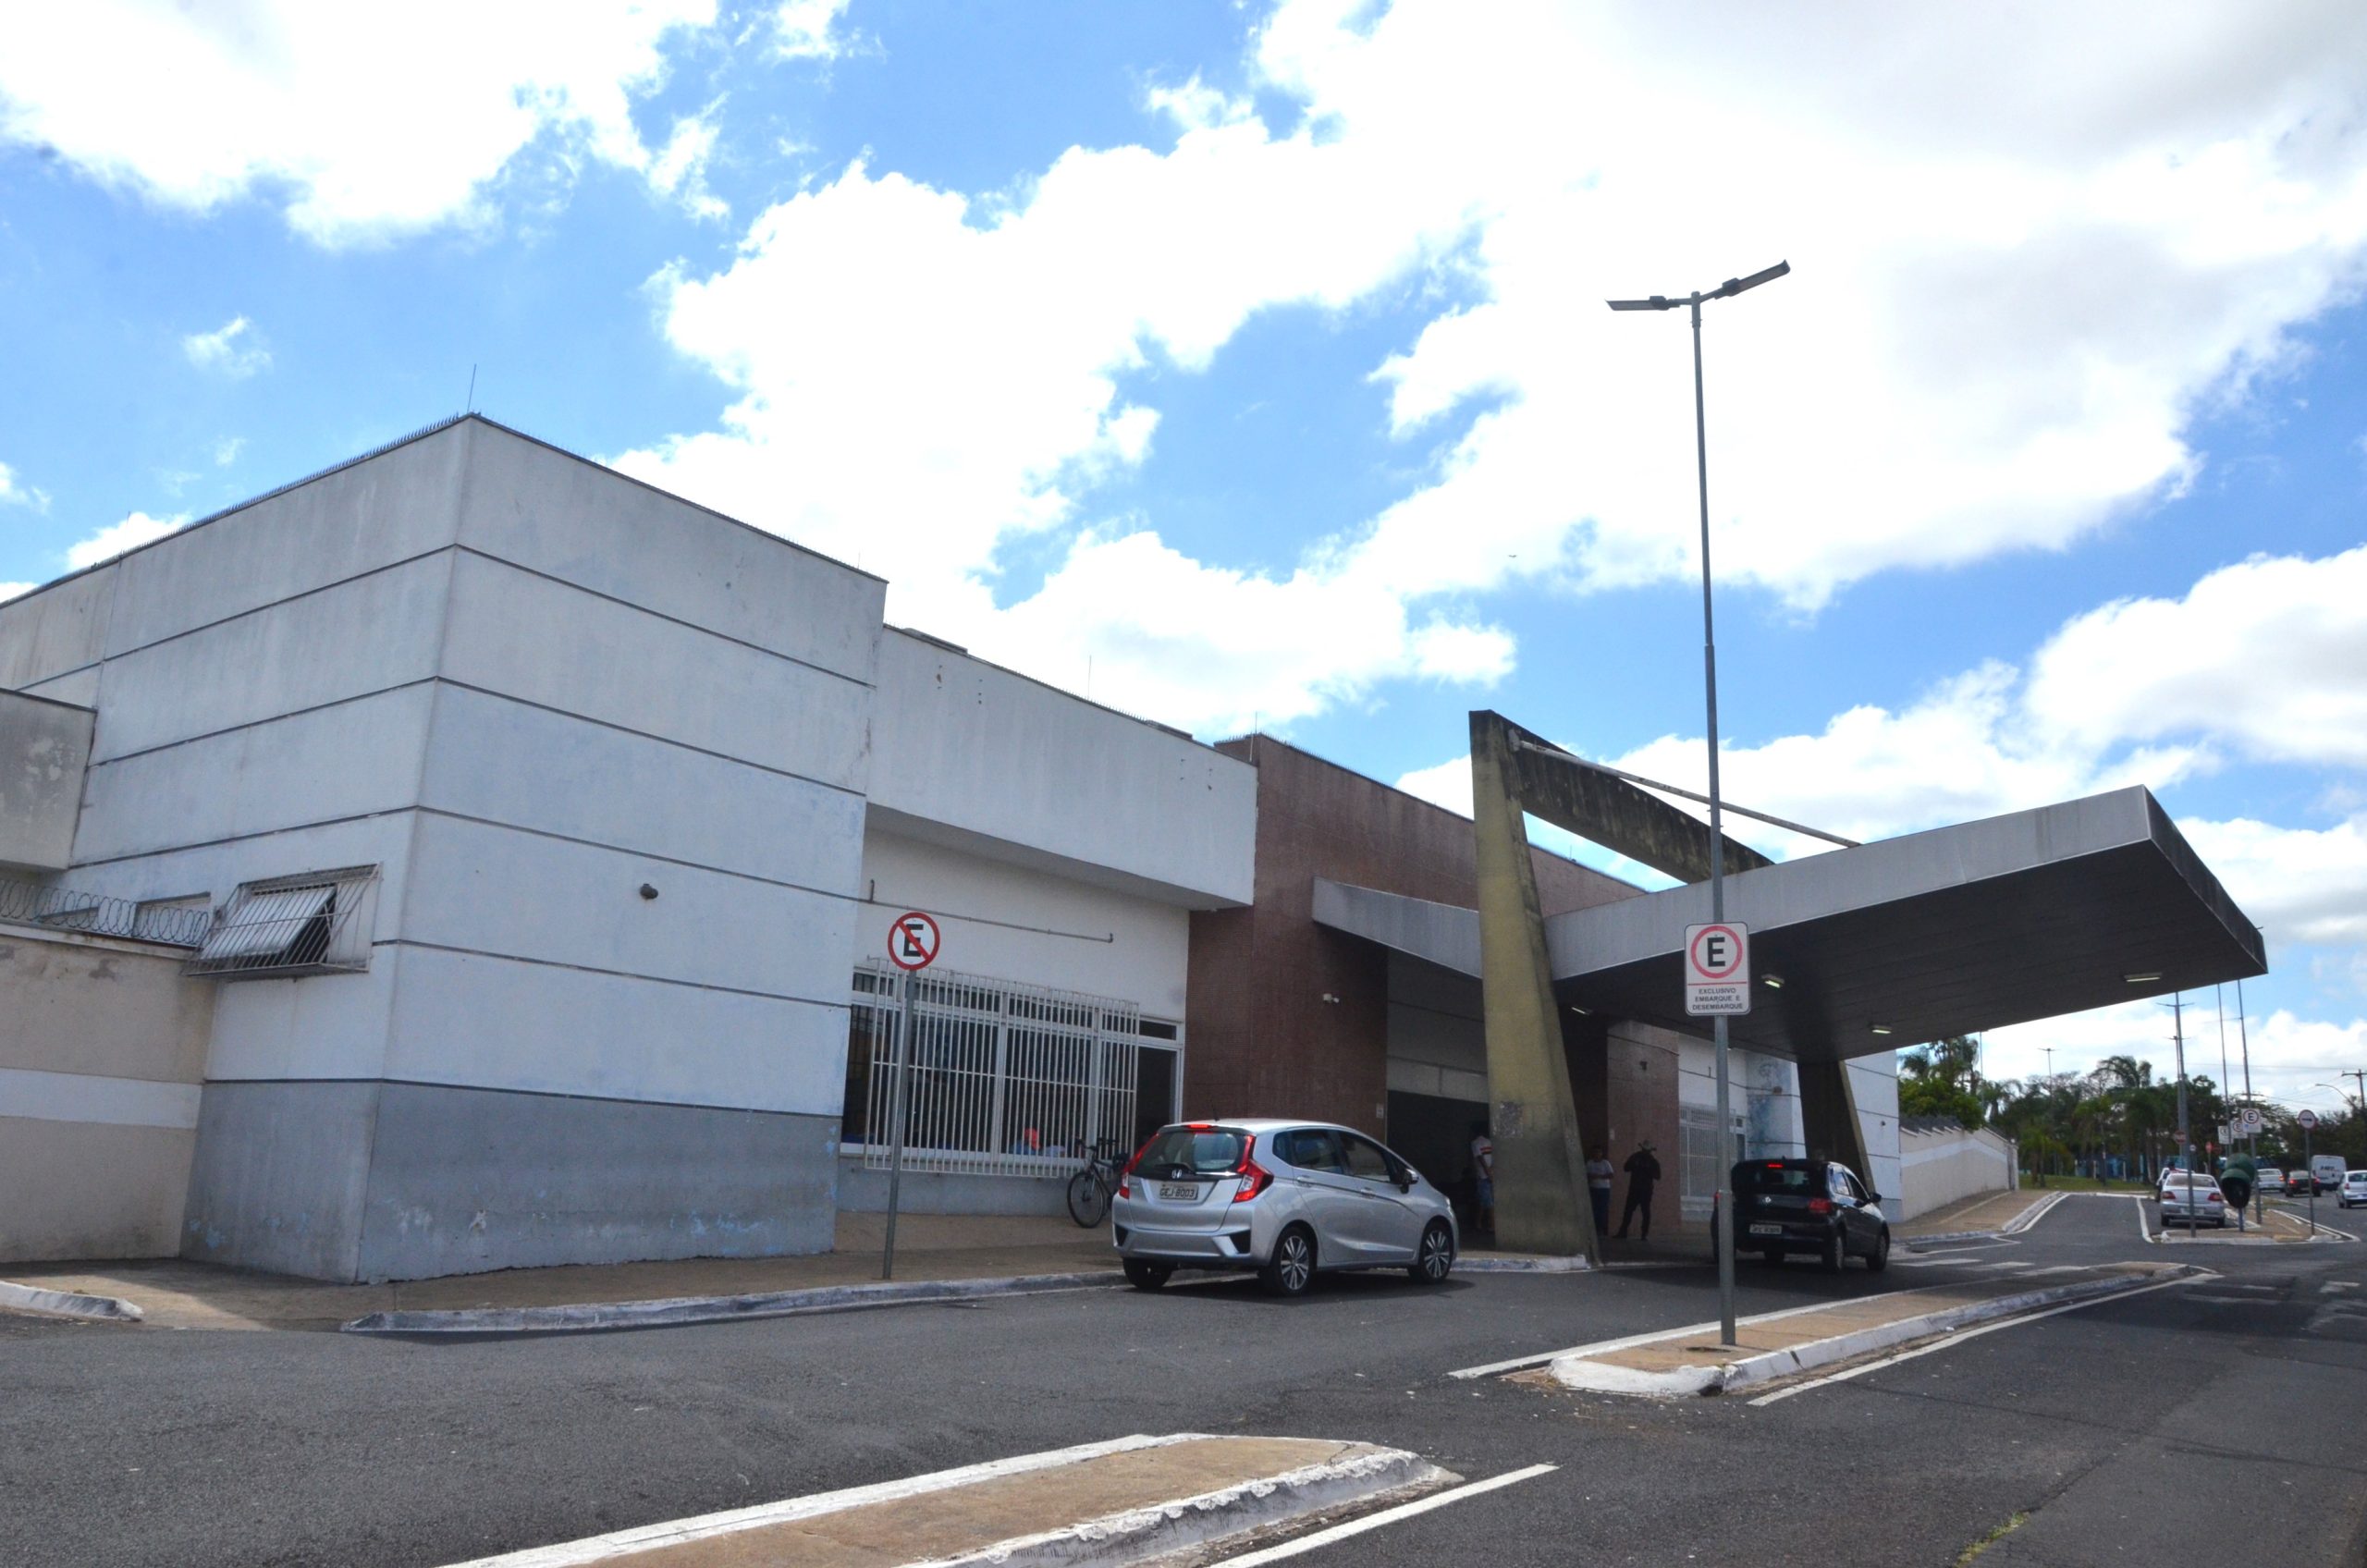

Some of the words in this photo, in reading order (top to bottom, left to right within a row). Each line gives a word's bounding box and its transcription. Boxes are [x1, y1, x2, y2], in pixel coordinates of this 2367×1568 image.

[903, 924, 924, 957] E
[1707, 937, 1725, 967] E
[2248, 1112, 2254, 1121] E
